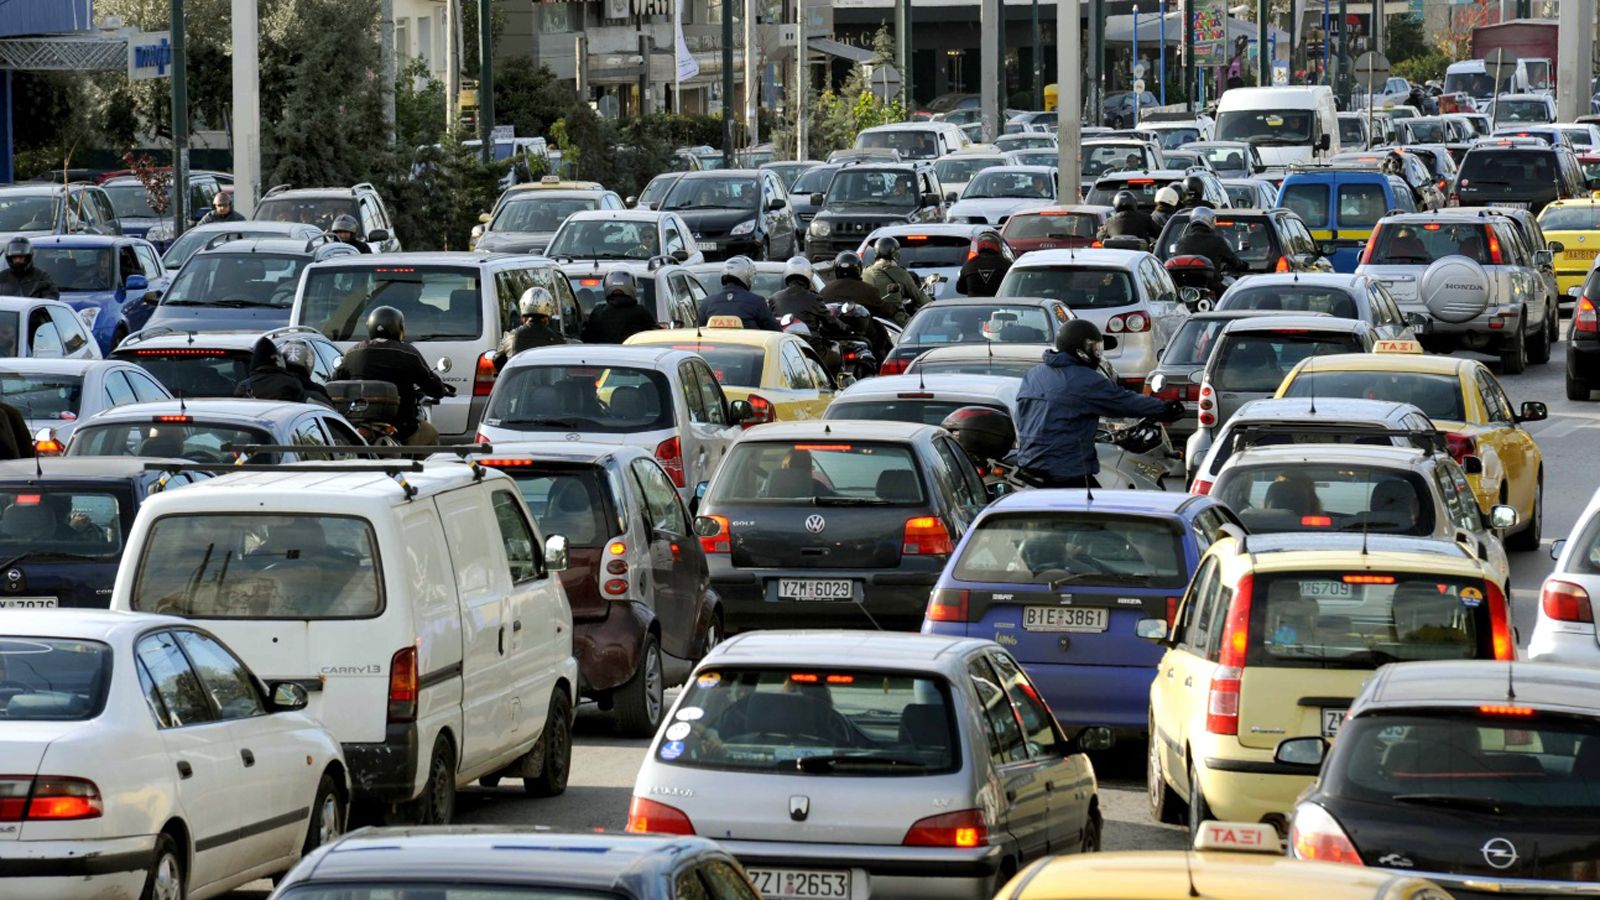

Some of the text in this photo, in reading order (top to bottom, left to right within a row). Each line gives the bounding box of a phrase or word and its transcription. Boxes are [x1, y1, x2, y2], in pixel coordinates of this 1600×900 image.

[1445, 283, 1484, 291] HONDA
[992, 593, 1014, 601] SEAT
[320, 666, 366, 674] CARRY
[1210, 827, 1263, 846] ΤΑΞΙ
